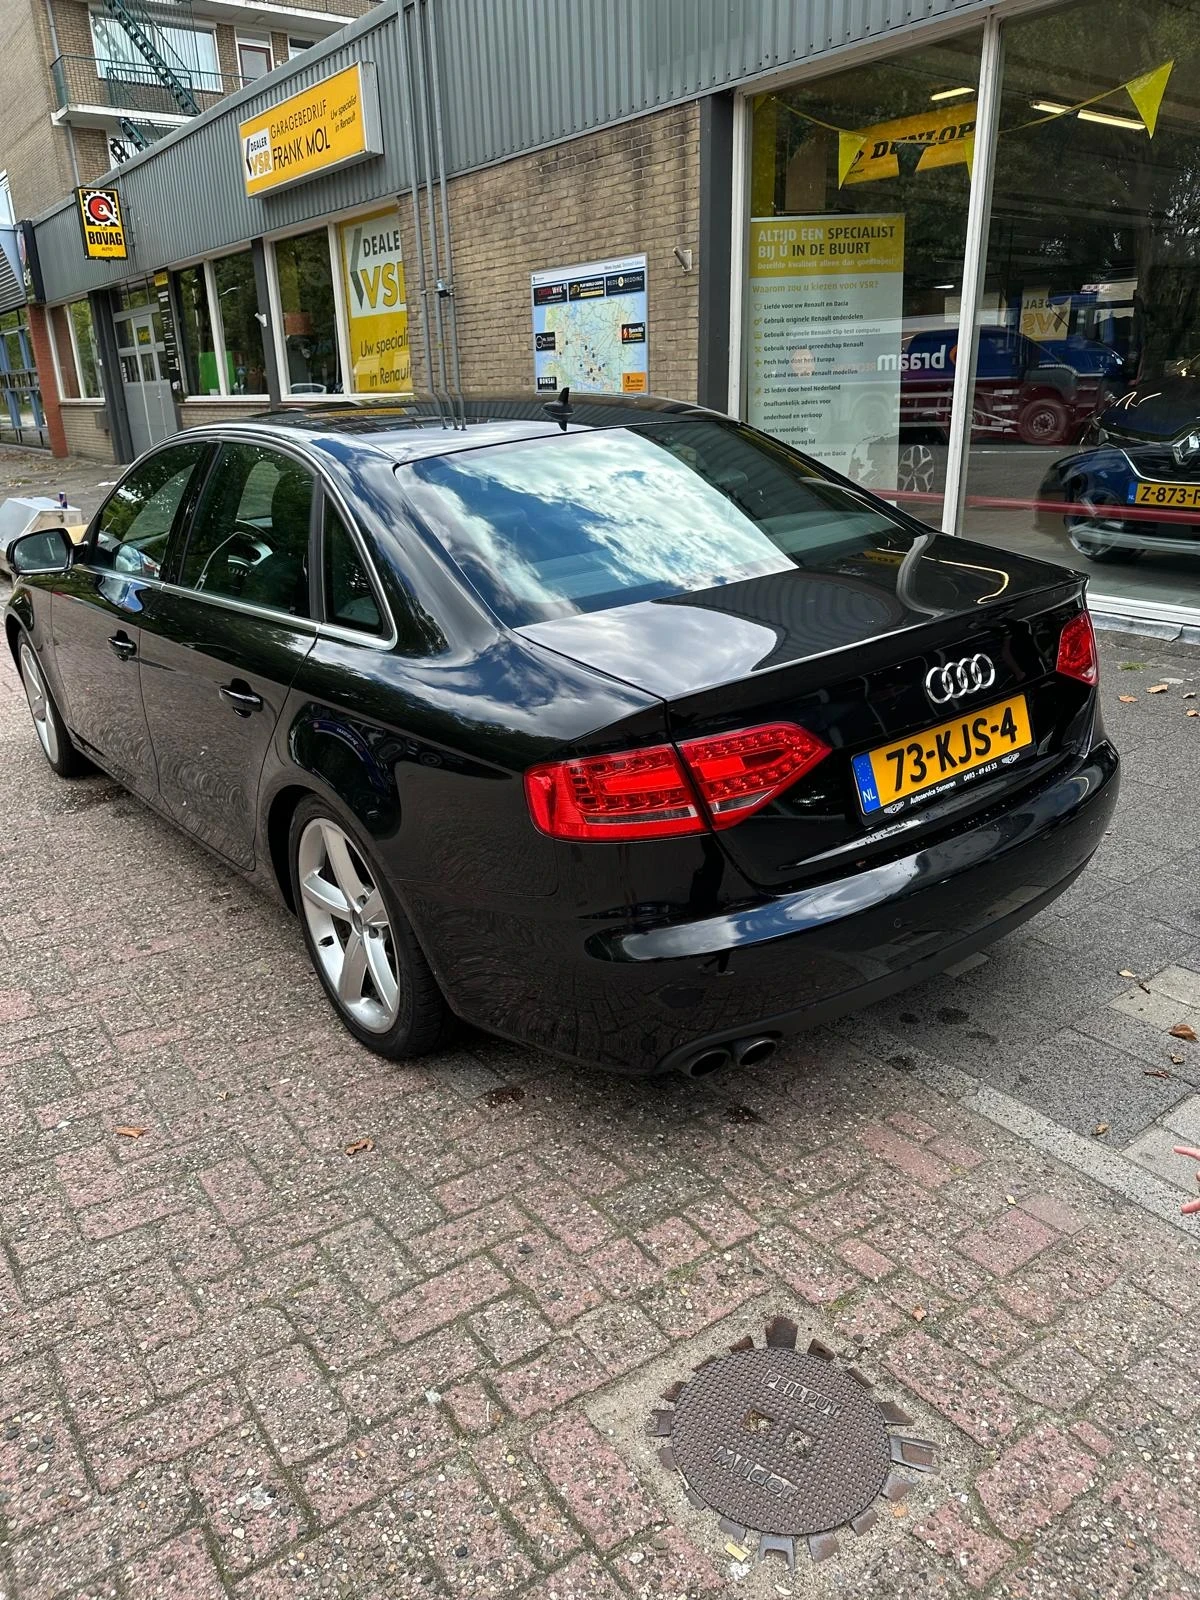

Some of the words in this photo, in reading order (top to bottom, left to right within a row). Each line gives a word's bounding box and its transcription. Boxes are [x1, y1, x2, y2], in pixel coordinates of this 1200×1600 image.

[330, 109, 338, 121] Uw
[338, 95, 357, 116] specialist
[270, 99, 327, 140] GARAGEBEDRIJF
[335, 122, 339, 133] in
[340, 111, 356, 130] Renault
[250, 137, 268, 152] DEALER
[272, 137, 304, 171] FRANK
[306, 126, 331, 157] MOL
[250, 150, 272, 177] VSR
[88, 231, 123, 246] BOVAG
[758, 228, 797, 247] ALTIJD
[801, 227, 824, 241] EEN
[828, 225, 895, 239] SPECIALIST
[758, 245, 775, 260] BIJ
[780, 244, 788, 257] U
[792, 244, 806, 257] IN
[810, 243, 825, 256] DE
[829, 242, 870, 255] BUURT
[752, 284, 786, 294] Waarom
[839, 281, 858, 289] voor
[803, 301, 825, 309] Renault
[763, 317, 785, 325] Gebruik
[786, 316, 810, 325] originele
[810, 315, 832, 323] Renault
[832, 313, 864, 321] onderdelen
[360, 340, 374, 357] Uw
[763, 344, 785, 352] Gebruik
[786, 343, 808, 352] speciaal
[763, 358, 777, 366] Pech
[816, 356, 835, 364] Europa
[369, 370, 377, 387] in
[813, 384, 841, 392] Nederland
[763, 413, 792, 421] onderhoud
[886, 706, 1018, 792] 73-KJS-4
[910, 789, 936, 806] Autoservice
[935, 781, 957, 794] Someren
[963, 771, 975, 782] 0493
[985, 764, 992, 773] 65
[991, 762, 998, 771] 33
[862, 788, 877, 804] NL
